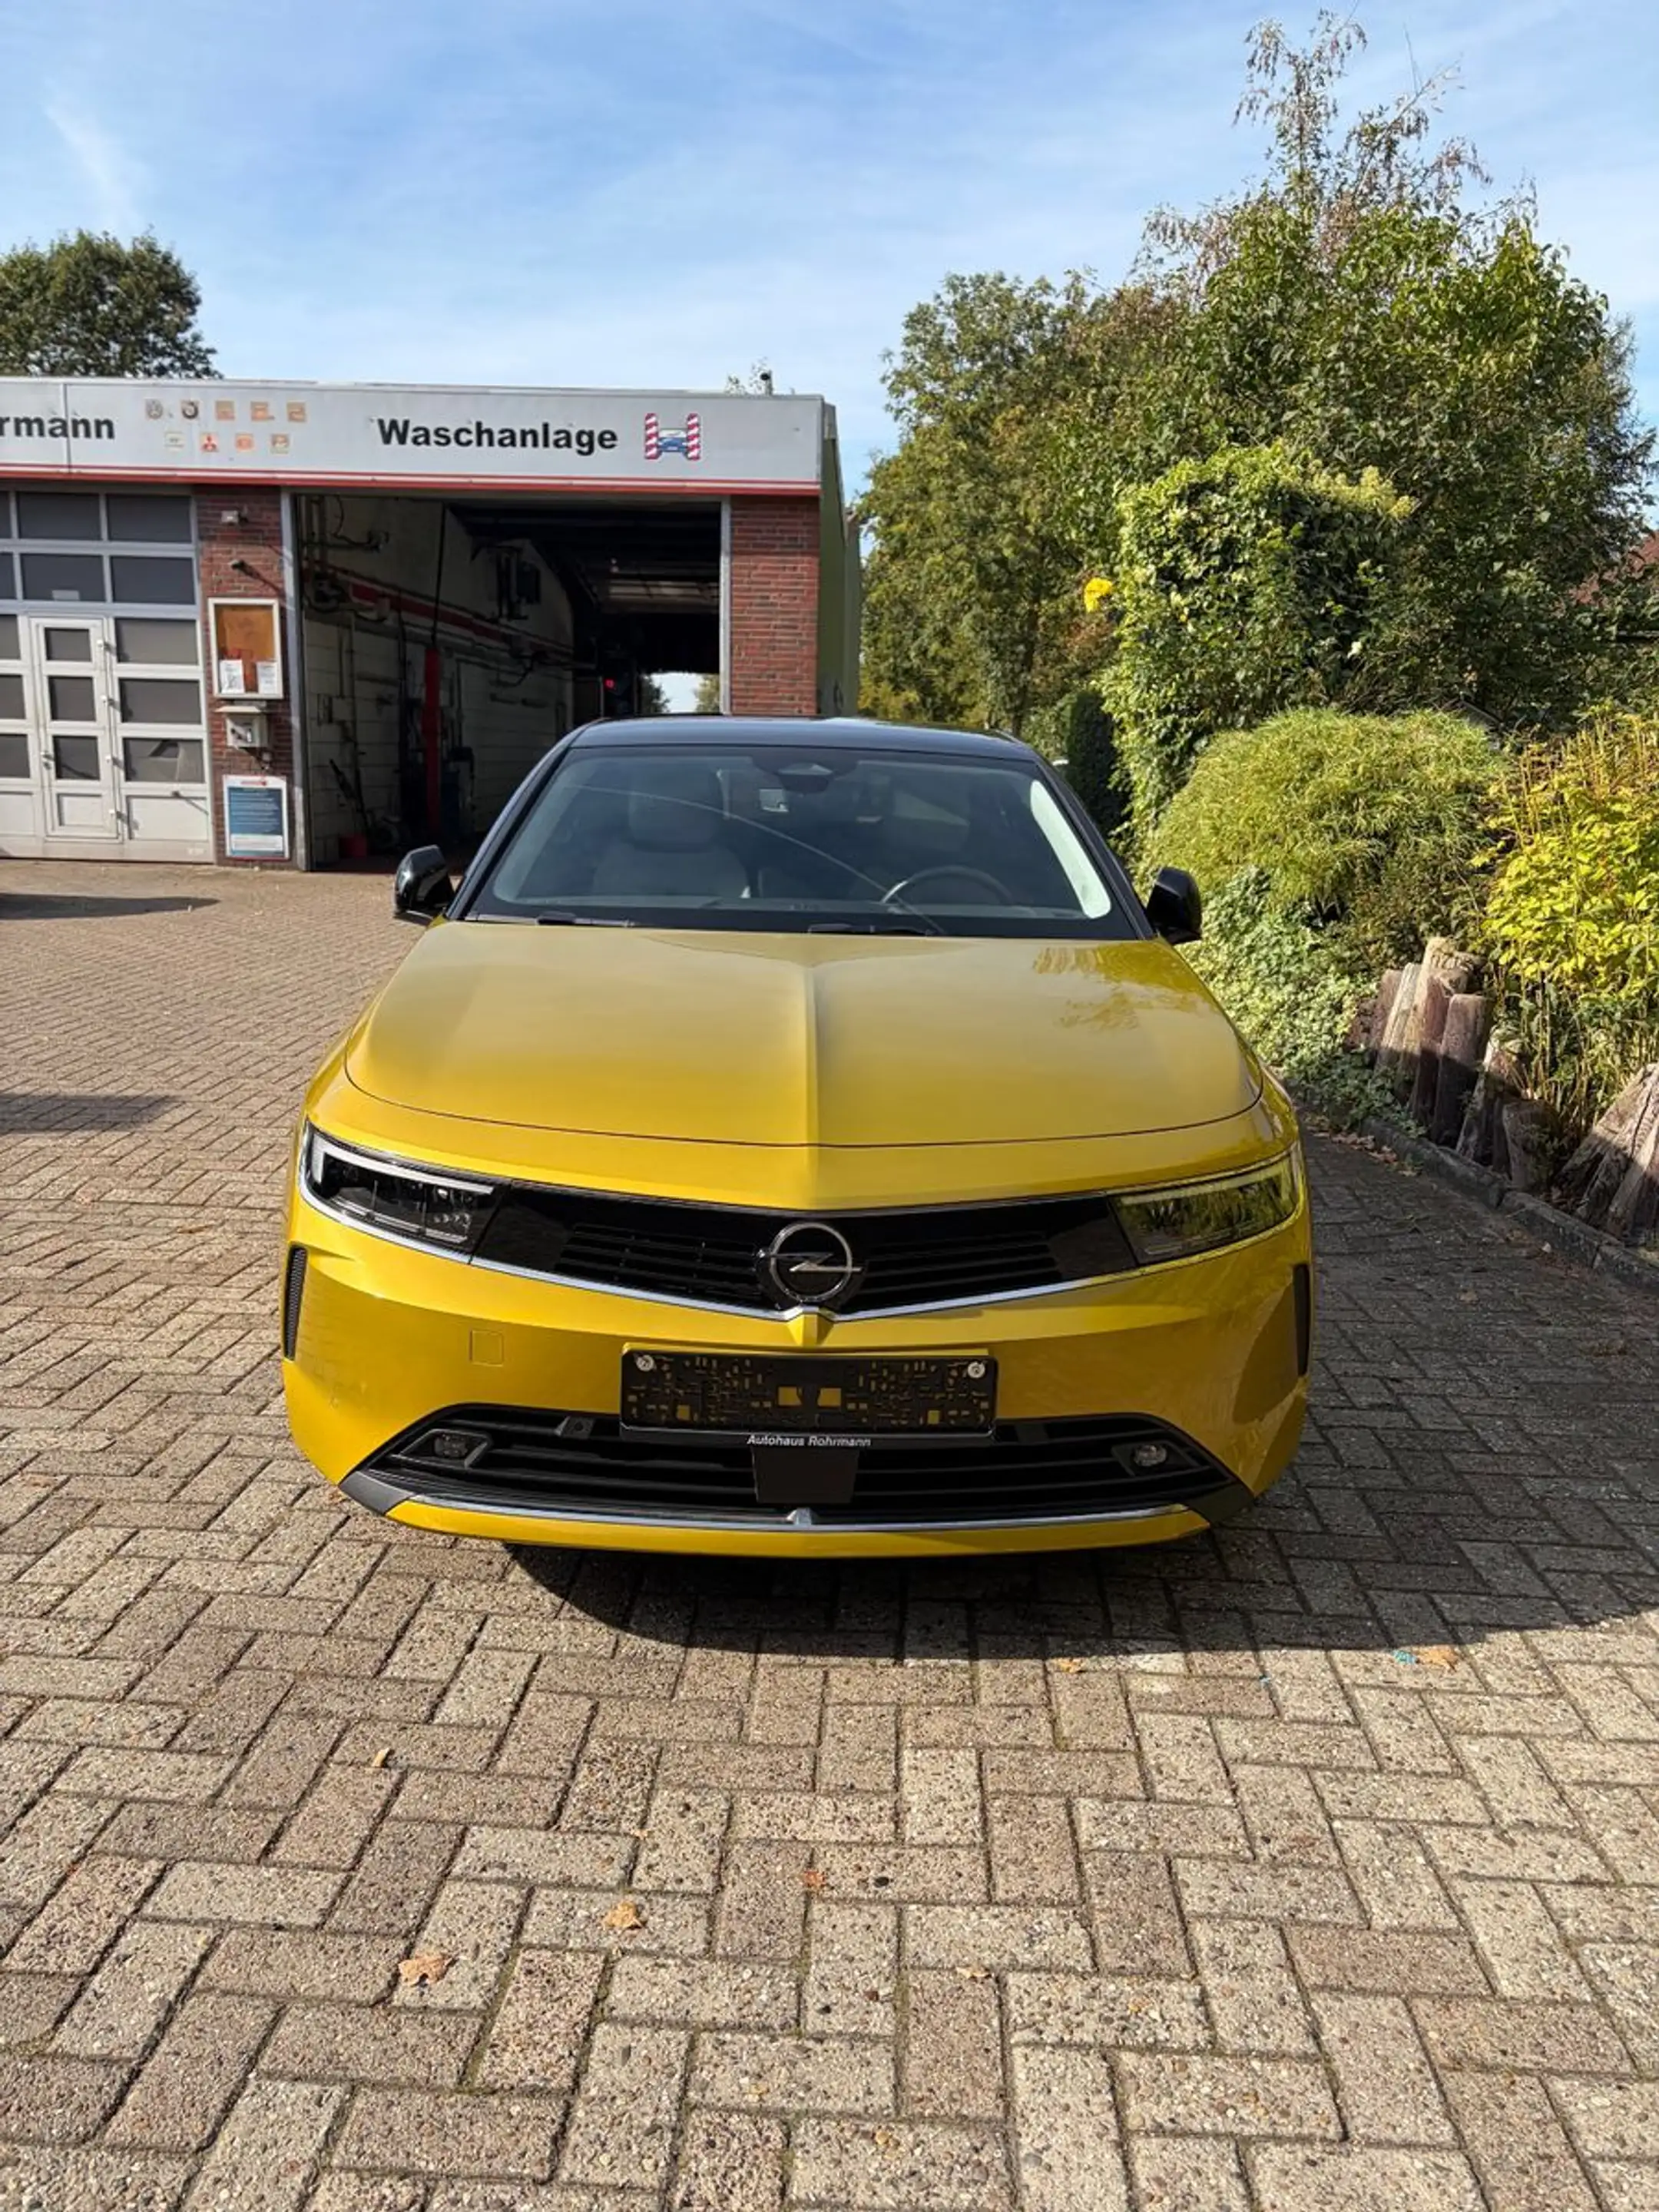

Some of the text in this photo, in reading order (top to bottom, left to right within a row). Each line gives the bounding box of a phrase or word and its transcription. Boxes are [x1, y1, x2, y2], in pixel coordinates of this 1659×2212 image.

[377, 418, 618, 456] Waschanlage
[746, 1434, 872, 1448] Autohaus Rohrmann
